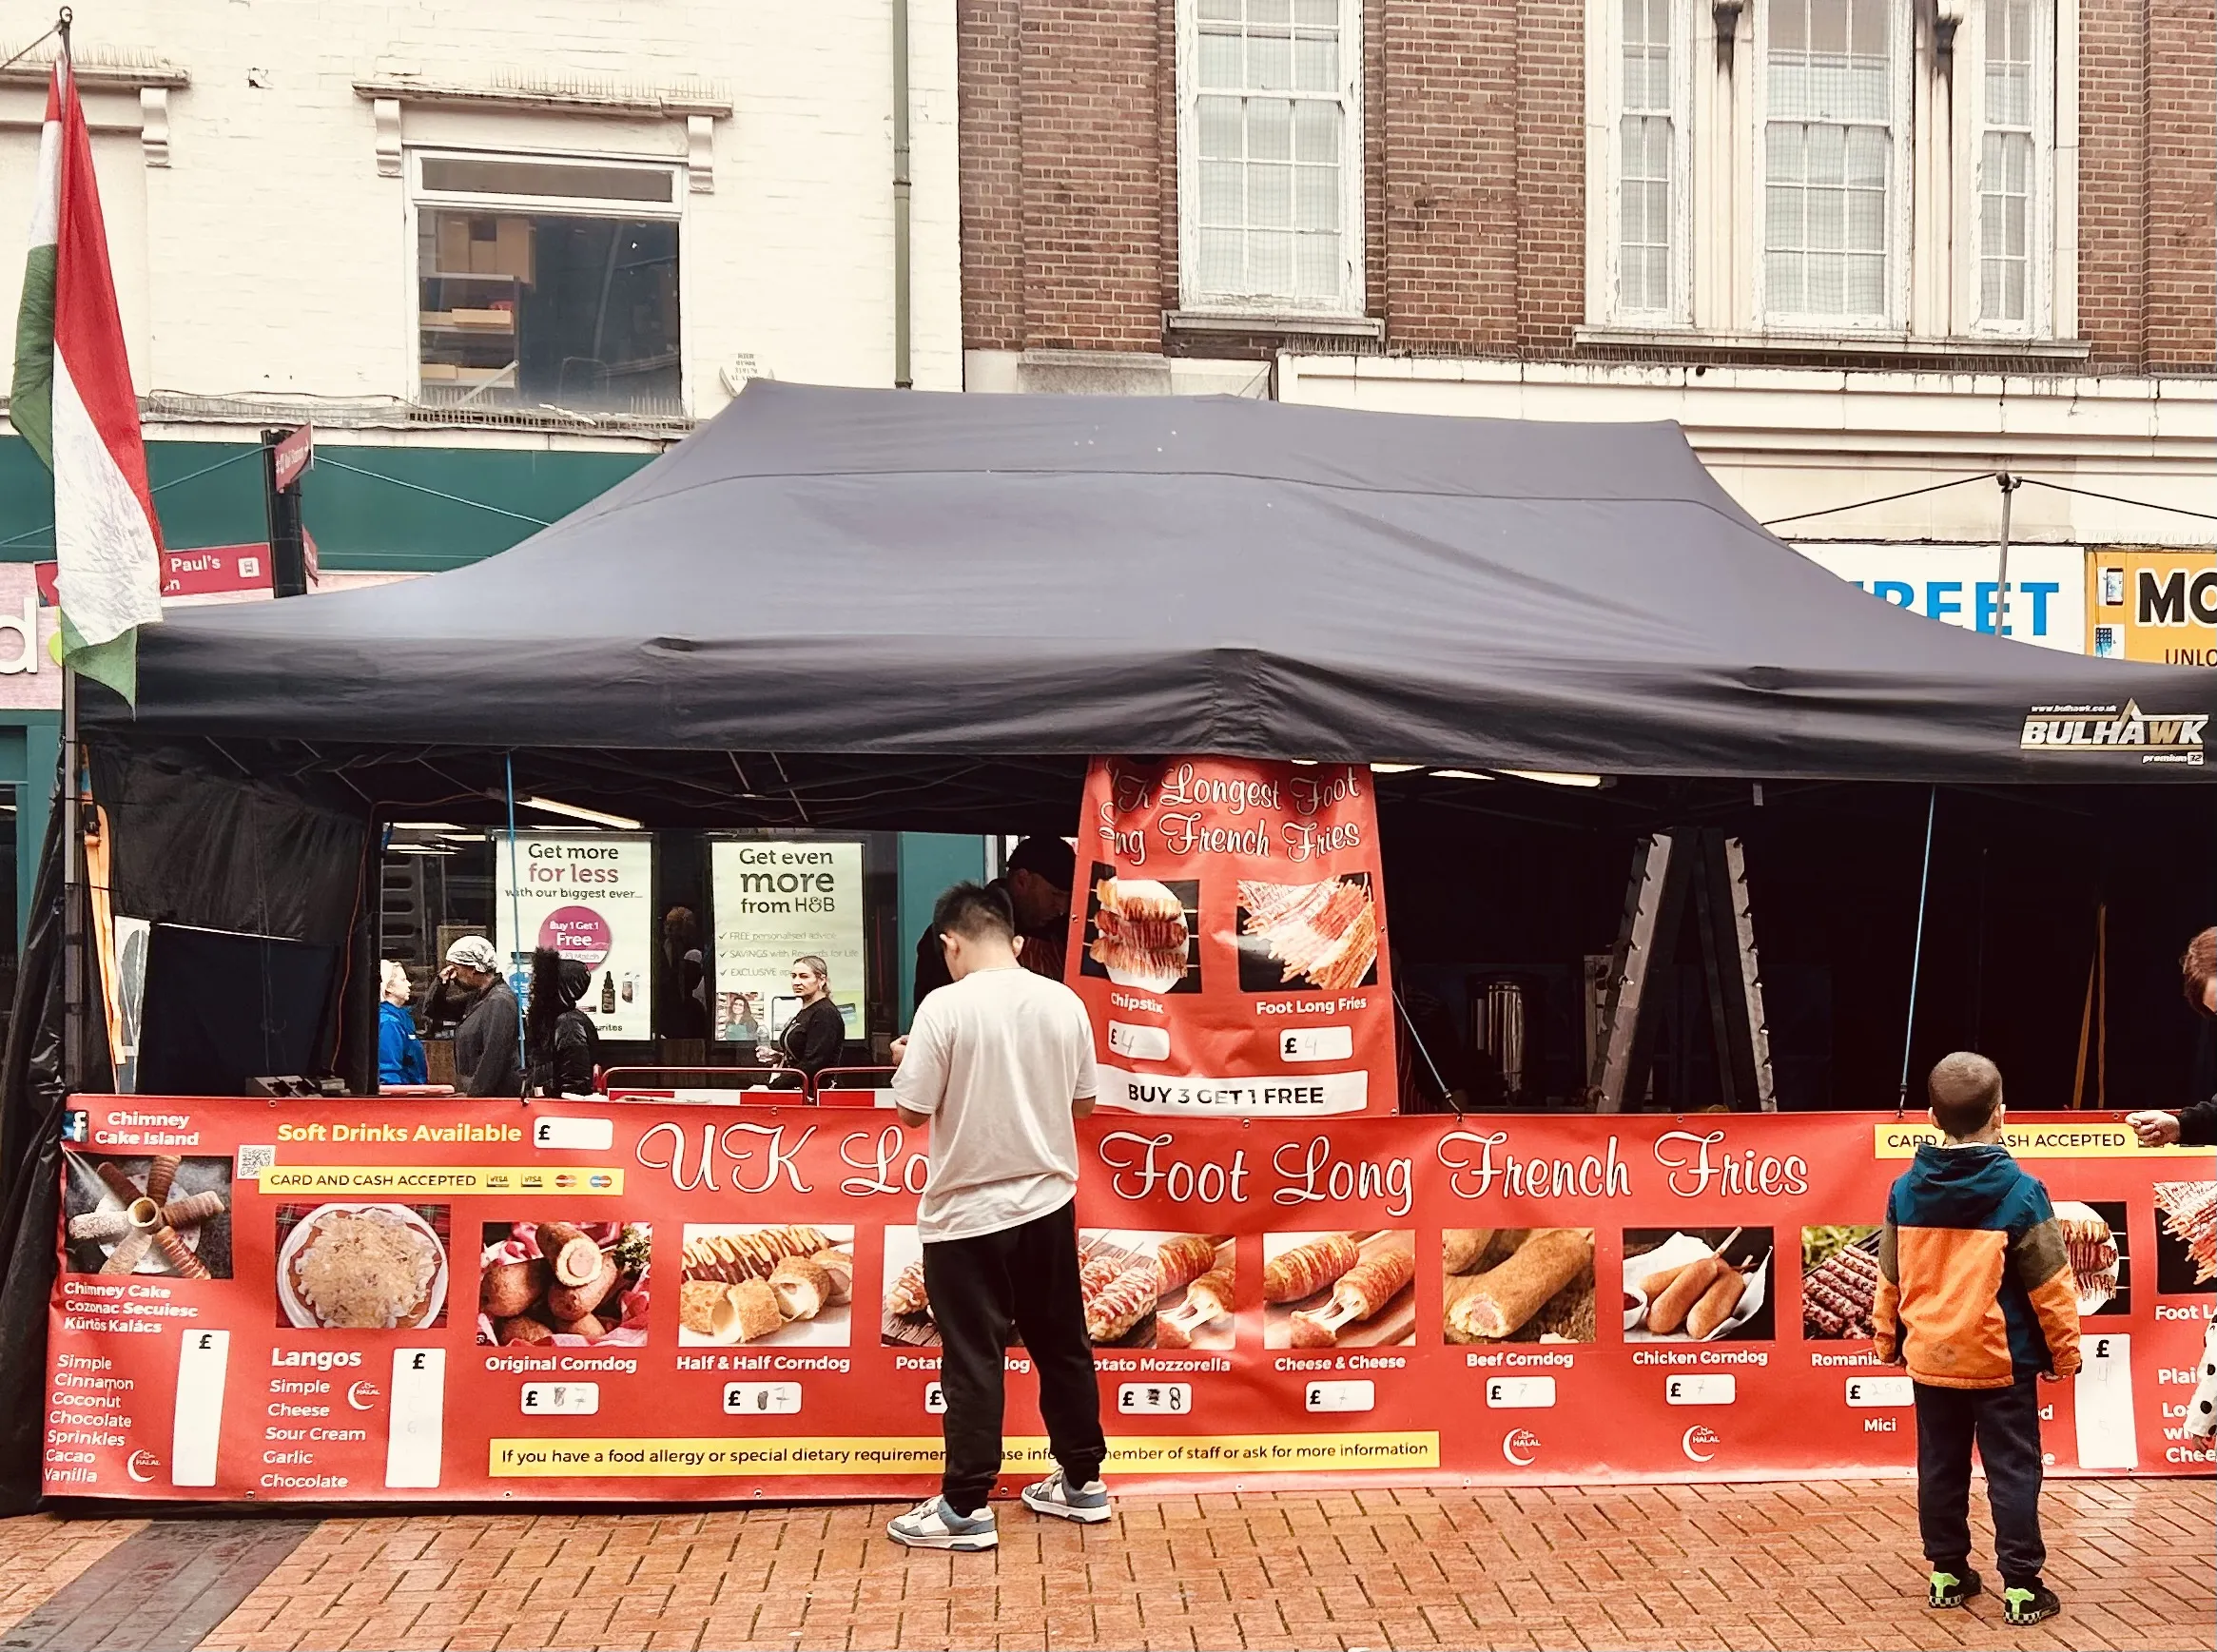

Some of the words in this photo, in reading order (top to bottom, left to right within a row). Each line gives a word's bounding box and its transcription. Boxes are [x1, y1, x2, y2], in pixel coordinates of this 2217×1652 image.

[171, 555, 222, 573] Paul's
[2020, 715, 2208, 746] BULHAWK
[1159, 763, 1281, 815] Longest
[1289, 767, 1360, 815] Foot
[1157, 812, 1271, 857] French
[1281, 821, 1361, 862] Fries
[528, 843, 562, 858] Get
[567, 846, 619, 860] more
[739, 848, 776, 865] Get
[781, 852, 834, 865] even
[529, 863, 566, 883] for
[571, 864, 619, 884] less
[740, 873, 835, 893] more
[535, 889, 558, 898] our
[560, 888, 606, 901] biggest
[741, 898, 791, 914] from
[795, 897, 835, 913] H&B
[550, 921, 568, 931] Buy
[576, 922, 593, 930] Get
[556, 932, 593, 946] Free
[729, 932, 749, 941] FREE
[729, 950, 768, 959] SAVINGS
[1111, 992, 1164, 1014] Chipstix
[1255, 1001, 1292, 1016] Foot
[1295, 1000, 1334, 1014] Long
[1337, 996, 1368, 1011] Fries
[1284, 1038, 1297, 1054] £
[1128, 1084, 1172, 1103] BUY
[1177, 1089, 1190, 1104] 3
[1196, 1090, 1244, 1104] GET
[1249, 1090, 1255, 1104] 1
[1264, 1087, 1325, 1104] FREE
[107, 1111, 191, 1130] Chimney
[95, 1130, 142, 1146] Cake
[144, 1131, 201, 1146] Island
[277, 1123, 327, 1142] Soft
[332, 1123, 409, 1142] Drinks
[412, 1123, 522, 1142] Available
[538, 1124, 551, 1140] £
[2034, 1134, 2126, 1148] ACCEPTED
[635, 1122, 814, 1194] UK
[1099, 1131, 1249, 1203] Foot
[1272, 1135, 1414, 1217] Long
[1436, 1131, 1633, 1200] French
[1653, 1130, 1809, 1200] Fries
[270, 1175, 312, 1187] CARD
[316, 1175, 350, 1187] AND
[354, 1175, 394, 1187] CASH
[398, 1175, 476, 1187] ACCEPTED
[64, 1282, 126, 1299] Chimney
[128, 1285, 171, 1299] Cake
[65, 1300, 120, 1314] Cozonac
[123, 1302, 199, 1318] Secuiesc
[2155, 1305, 2200, 1320] Foot
[108, 1319, 163, 1333] Kalács
[199, 1334, 212, 1350] £
[2096, 1340, 2110, 1357] £
[57, 1354, 112, 1371] Simple
[272, 1348, 362, 1371] Langos
[413, 1353, 425, 1370] £
[485, 1355, 556, 1373] Original
[560, 1357, 637, 1374] Corndog
[676, 1355, 715, 1371] Half
[717, 1357, 730, 1370] &
[732, 1355, 771, 1371] Half
[773, 1356, 851, 1373] Corndog
[1274, 1357, 1332, 1371] Cheese
[1334, 1357, 1347, 1370] &
[1349, 1355, 1407, 1370] Cheese
[1467, 1352, 1504, 1367] Beef
[1506, 1352, 1574, 1370] Corndog
[1632, 1351, 1698, 1366] Chicken
[1701, 1351, 1769, 1368] Corndog
[54, 1372, 135, 1390] Cinnamon
[269, 1379, 331, 1396] Simple
[1670, 1382, 1682, 1397] £
[51, 1391, 121, 1408] Coconut
[526, 1390, 537, 1406] £
[728, 1390, 741, 1407] £
[929, 1390, 942, 1406] £
[1122, 1391, 1135, 1406] £
[1169, 1387, 1181, 1410] 8
[1310, 1390, 1321, 1405] £
[1491, 1385, 1502, 1400] £
[1850, 1385, 1861, 1400] £
[49, 1410, 131, 1428] Chocolate
[268, 1403, 330, 1419] Cheese
[1864, 1417, 1897, 1431] Mici
[47, 1429, 126, 1448] Sprinkles
[265, 1427, 307, 1442] Sour
[309, 1427, 366, 1442] Cream
[1692, 1435, 1720, 1444] HALAL
[45, 1448, 96, 1464] Cacao
[263, 1448, 315, 1466] Garlic
[502, 1449, 514, 1463] If
[516, 1452, 548, 1467] you
[552, 1449, 591, 1463] have
[594, 1452, 603, 1463] a
[608, 1448, 646, 1463] food
[650, 1448, 705, 1466] allergy
[709, 1452, 727, 1462] or
[730, 1448, 788, 1466] special
[792, 1448, 849, 1465] dietary
[1168, 1446, 1184, 1460] of
[1187, 1445, 1220, 1460] staff
[1223, 1448, 1238, 1459] or
[1242, 1445, 1268, 1459] ask
[1272, 1445, 1293, 1459] for
[1296, 1448, 1335, 1458] more
[1340, 1442, 1429, 1458] information
[44, 1467, 98, 1484] Vanilla
[261, 1473, 349, 1490] Chocolate
